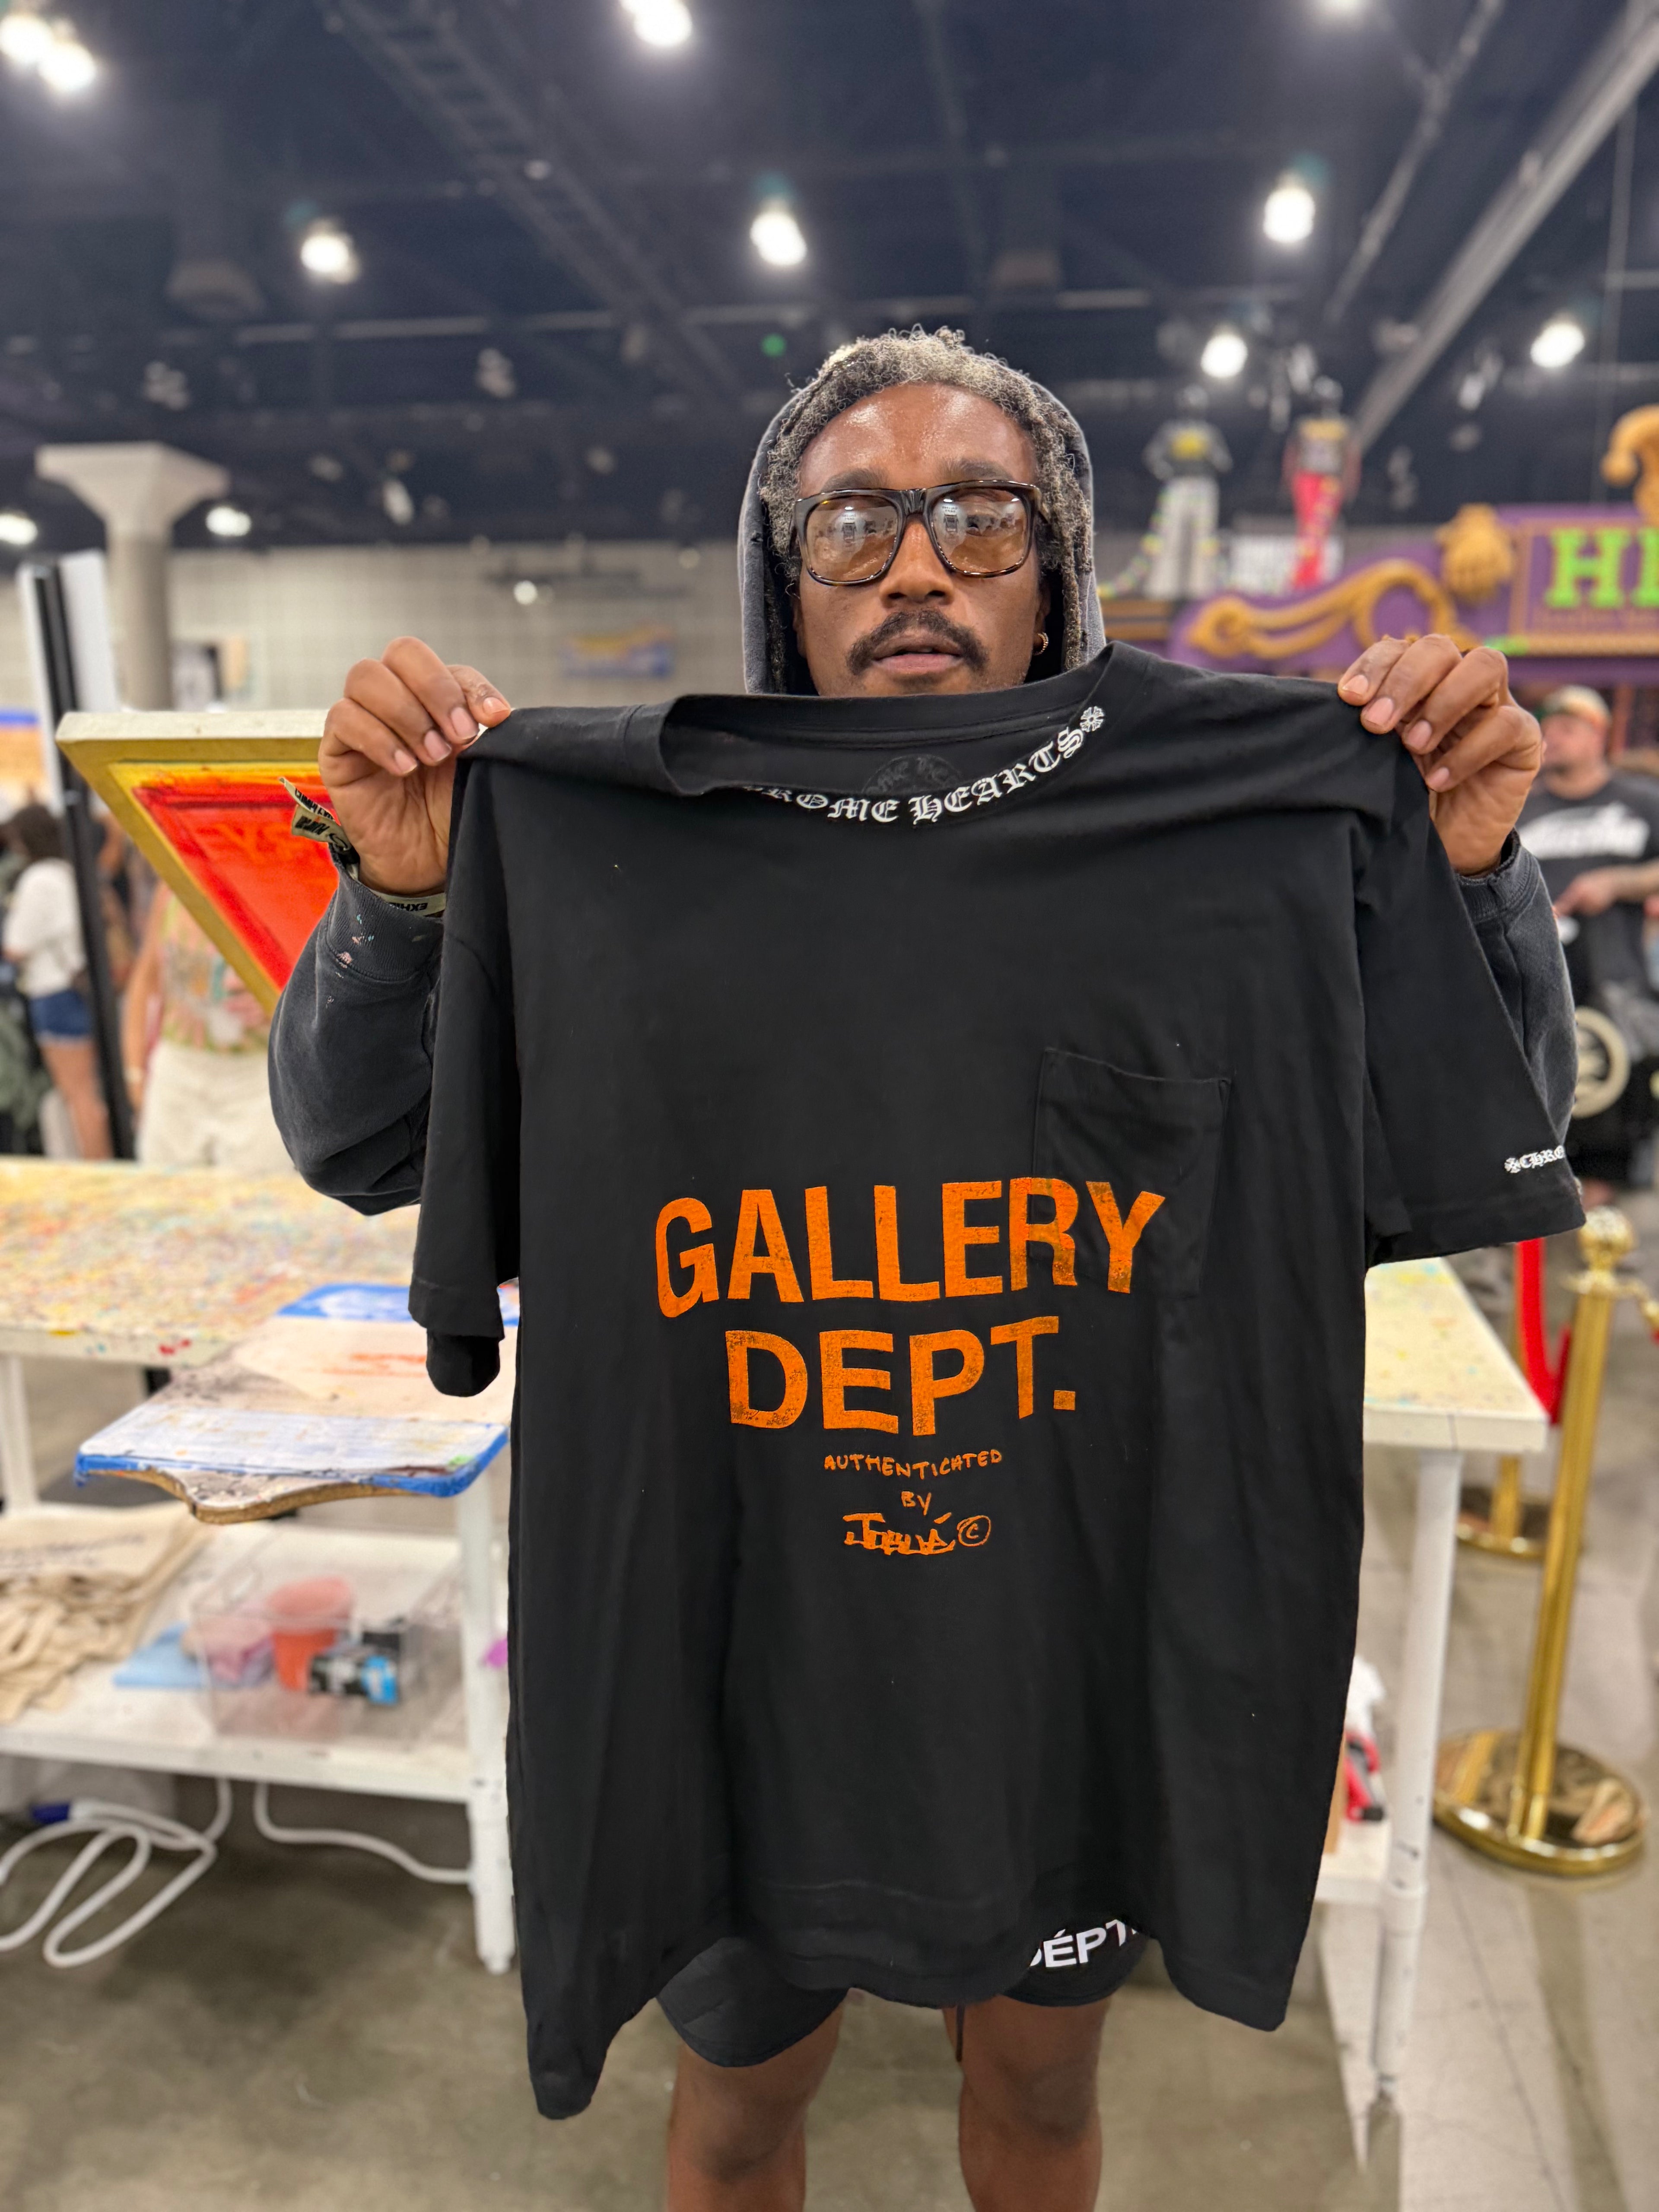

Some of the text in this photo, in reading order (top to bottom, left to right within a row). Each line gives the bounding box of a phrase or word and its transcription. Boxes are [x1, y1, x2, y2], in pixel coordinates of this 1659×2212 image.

[742, 786, 900, 823] ROME
[909, 727, 1084, 825] HEARTS
[655, 1177, 1166, 1318] GALLERY
[725, 1316, 1076, 1436] DEPT.
[824, 1449, 1002, 1480] AUTHENTICATED
[901, 1491, 931, 1516] BY
